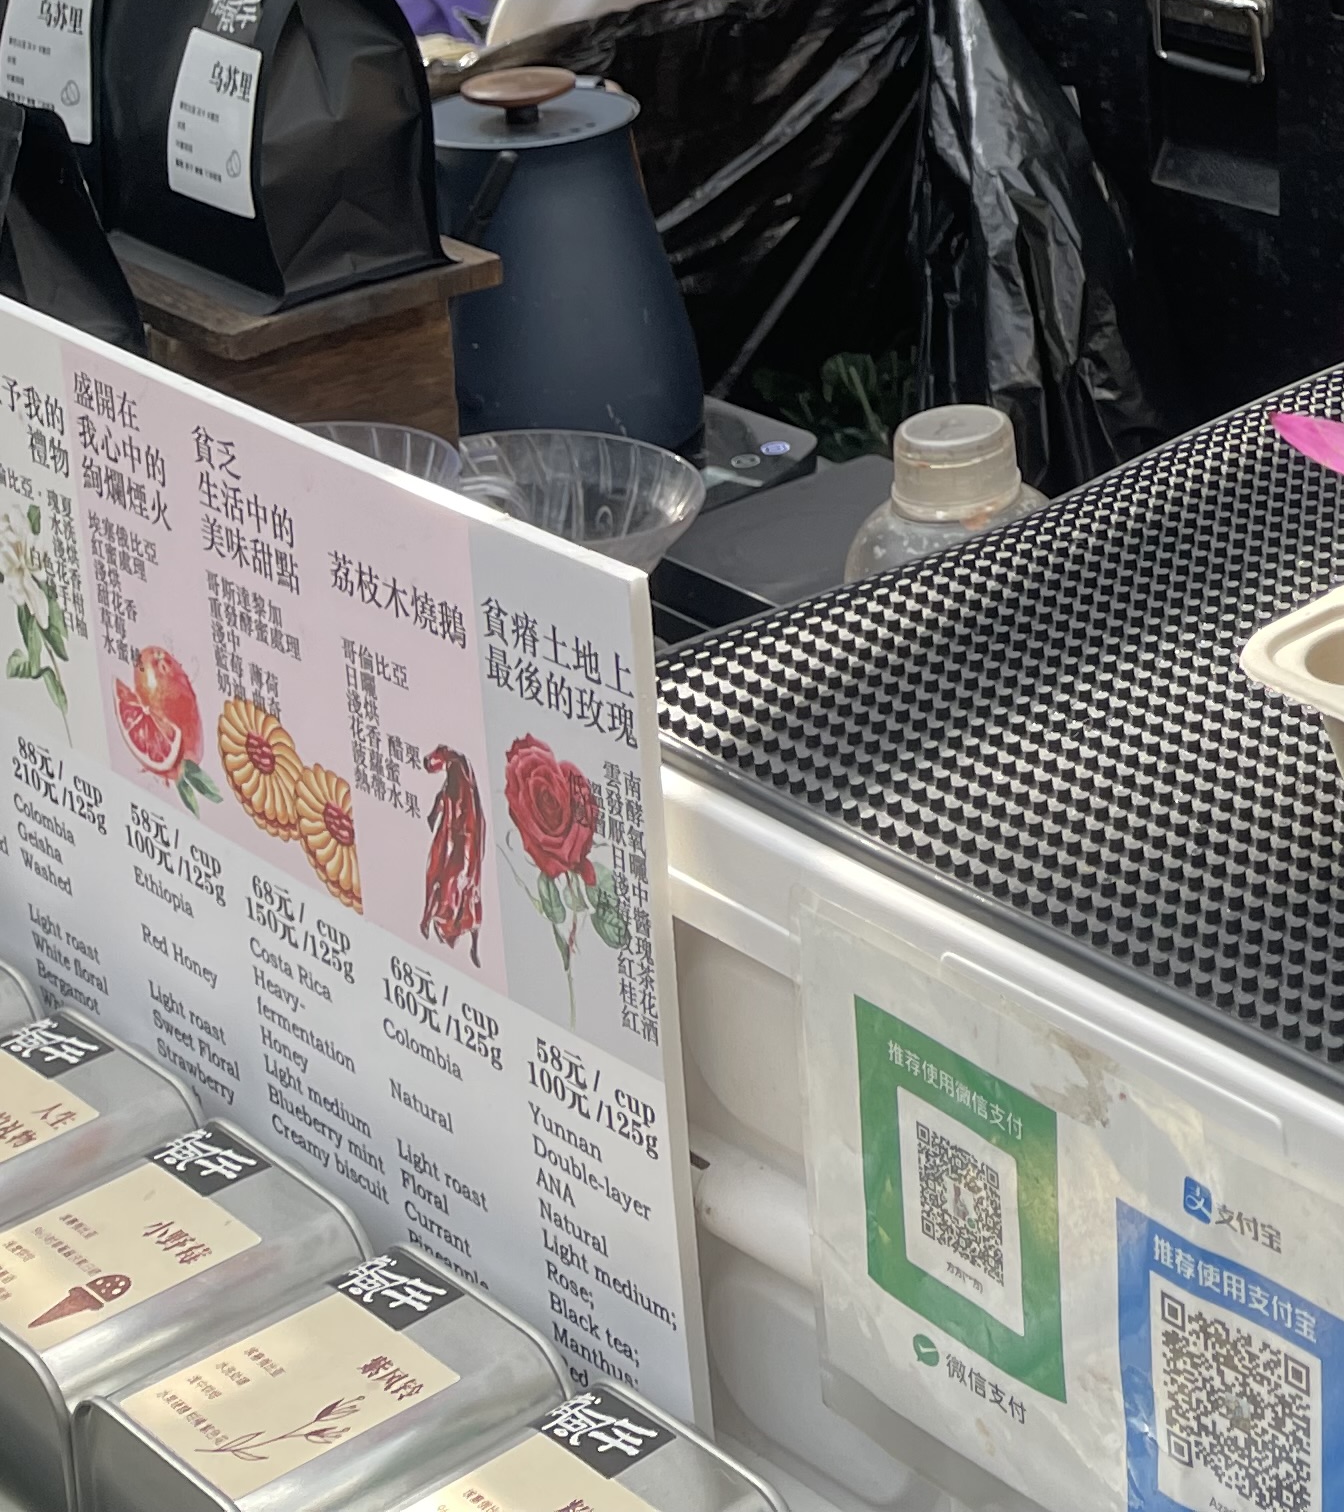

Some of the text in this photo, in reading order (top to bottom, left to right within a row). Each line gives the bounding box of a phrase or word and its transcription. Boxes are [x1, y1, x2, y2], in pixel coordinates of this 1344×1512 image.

[0, 375, 64, 437] 予我的
[74, 371, 139, 432] 盛開在
[27, 424, 69, 479] 禮物
[77, 414, 166, 488] 我心中的
[191, 425, 241, 481] 貧乏
[82, 454, 172, 531] 絢爛煙火
[199, 471, 294, 548] 生活中的
[201, 513, 300, 595] 美味甜點
[328, 550, 466, 649] 荔枝木燒鵝
[340, 635, 409, 690] 哥倫比亞
[481, 597, 634, 698] 貧瘠土地上
[485, 644, 638, 749] 最後的玫瑰
[13, 792, 76, 846] Colombia
[73, 774, 103, 805] cup
[17, 821, 63, 864] Geisha
[20, 848, 72, 896] Washed
[190, 844, 221, 877] cup
[133, 864, 194, 918] Ethiopia
[28, 903, 100, 965] Light roast
[31, 931, 70, 971] White
[141, 923, 218, 989] Red Honey
[317, 919, 350, 954] cup
[35, 958, 100, 1015] Bergamot
[250, 937, 333, 1003] Costa Rica
[253, 965, 306, 1013] Heavy-
[148, 979, 226, 1046] Light roast
[257, 996, 356, 1074] fermentation
[462, 1002, 499, 1040] cup
[152, 1009, 240, 1081] Sweet Floral
[156, 1037, 234, 1105] Strawberry
[260, 1025, 309, 1074] Honey
[383, 1016, 463, 1082] Colombia
[264, 1054, 372, 1139] Light medium
[389, 1078, 454, 1135] Natural
[614, 1088, 656, 1127] cup
[887, 1039, 1024, 1142] 推荐使用微信支付
[267, 1083, 386, 1175] Blueberry mint
[271, 1114, 391, 1205] Creamy biscuit
[528, 1101, 602, 1164] Yunnan
[397, 1138, 488, 1213] Light roast
[401, 1169, 450, 1217] Floral
[532, 1134, 651, 1221] Double-layer
[536, 1168, 575, 1208] ANA
[404, 1199, 473, 1260] Currant
[539, 1197, 608, 1259] Natural
[1214, 1202, 1282, 1255] 支付宝
[542, 1228, 677, 1332] Light medium;
[545, 1259, 595, 1310] Rose;
[1152, 1233, 1318, 1344] 推荐使用支付宝
[548, 1290, 640, 1367] Black tea;
[945, 1353, 1028, 1426] 微信支付
